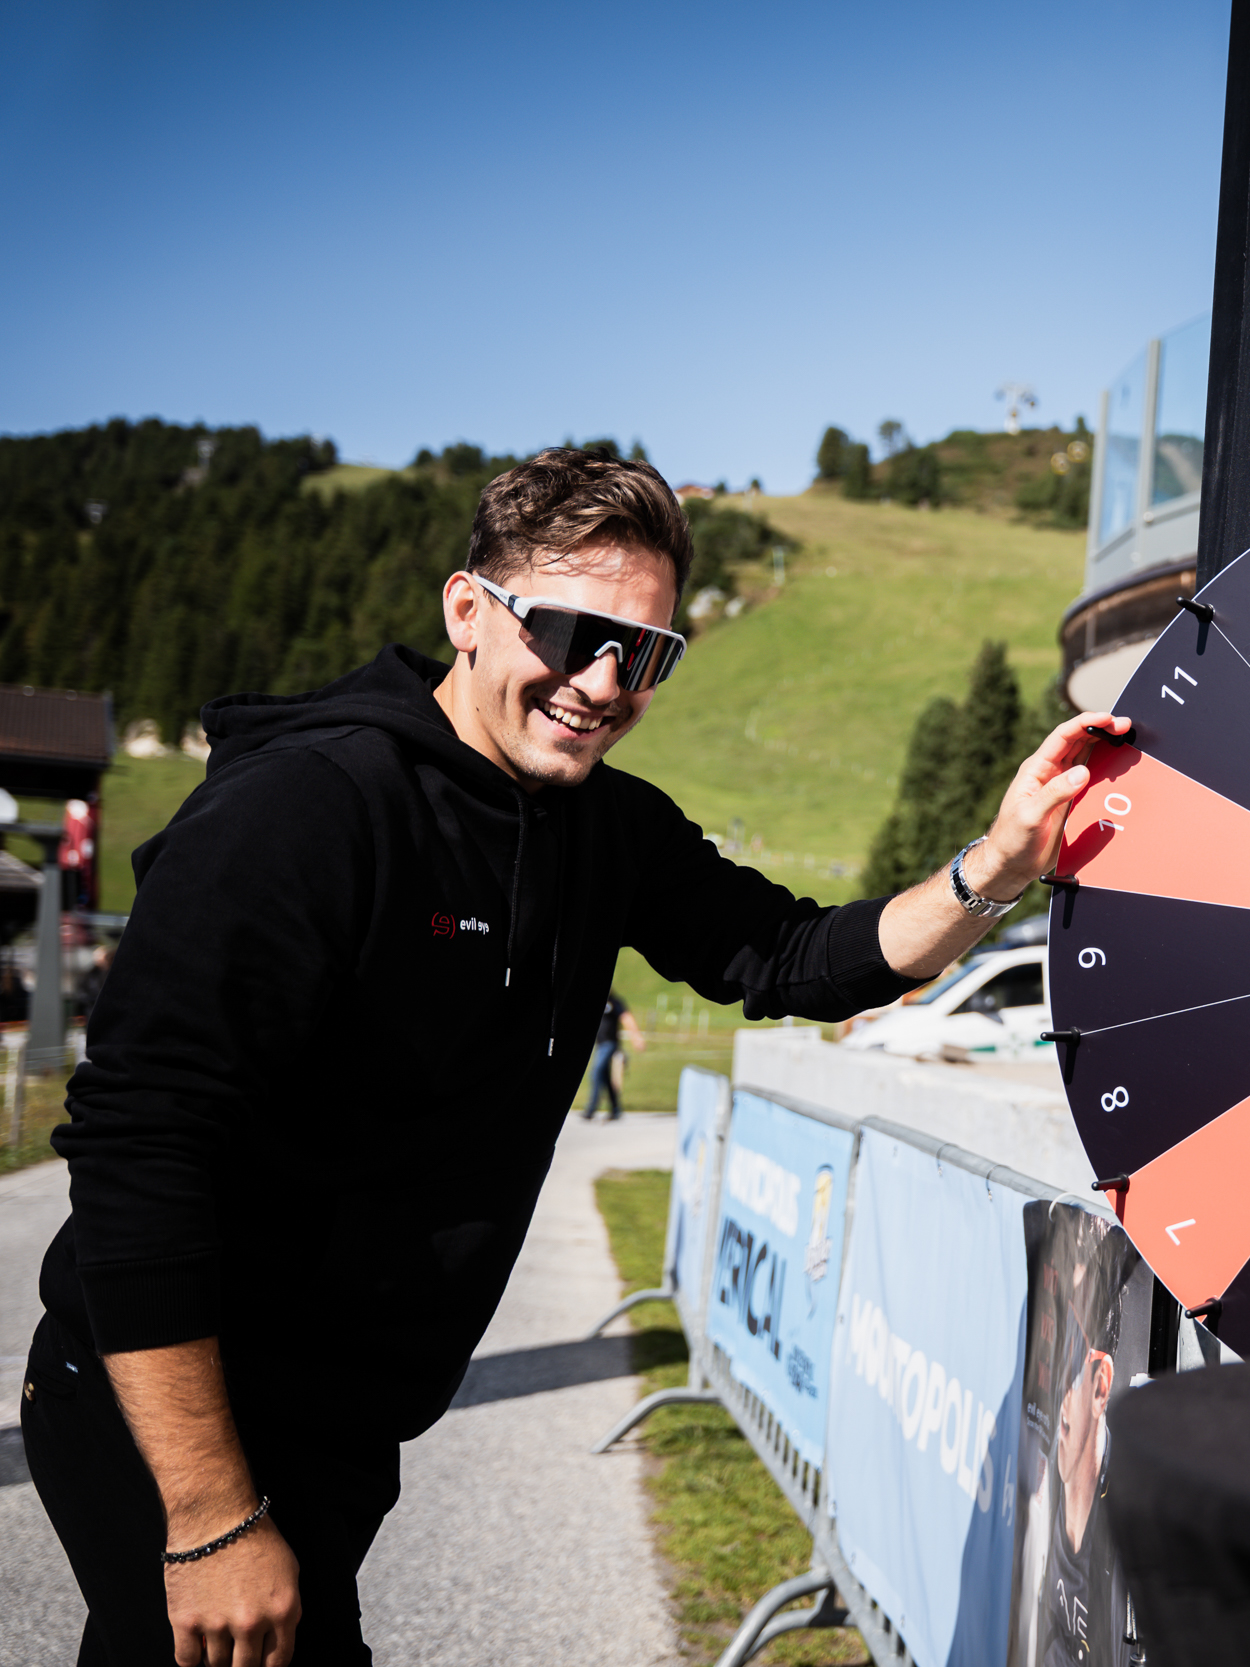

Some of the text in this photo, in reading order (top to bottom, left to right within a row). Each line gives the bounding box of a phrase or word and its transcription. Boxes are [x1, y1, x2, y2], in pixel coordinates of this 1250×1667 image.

[1161, 666, 1198, 705] 11
[1098, 792, 1132, 832] 10
[459, 916, 477, 931] evil
[1077, 946, 1106, 970] 9
[1100, 1085, 1129, 1112] 8
[1164, 1218, 1197, 1246] 7
